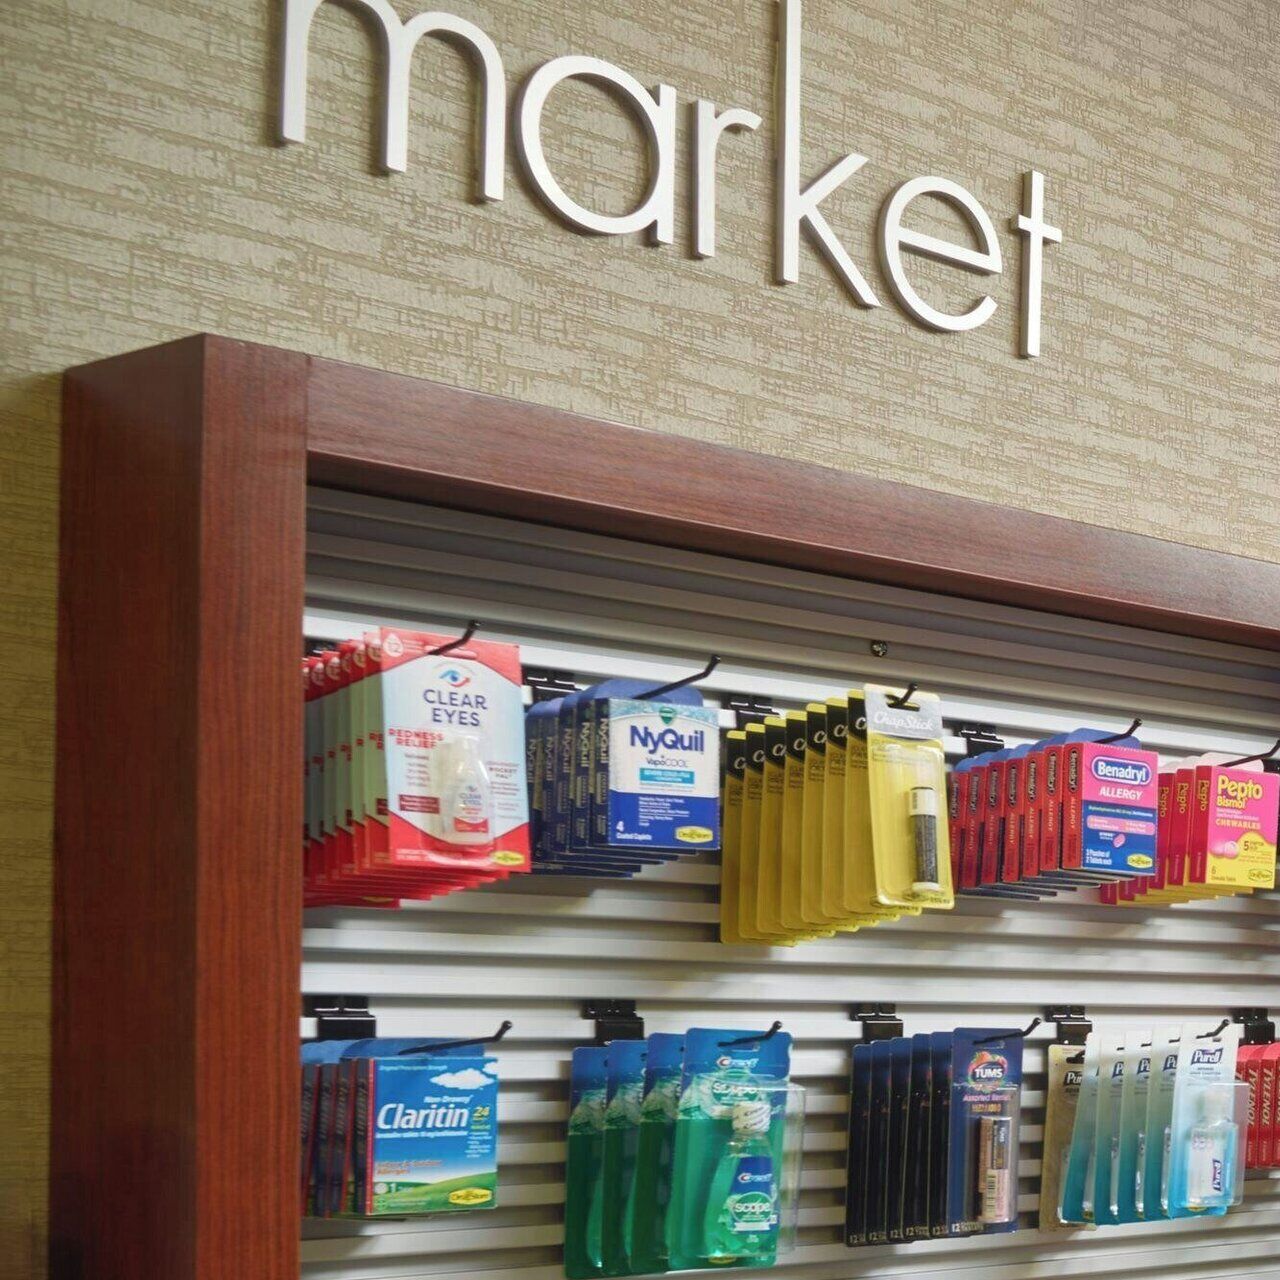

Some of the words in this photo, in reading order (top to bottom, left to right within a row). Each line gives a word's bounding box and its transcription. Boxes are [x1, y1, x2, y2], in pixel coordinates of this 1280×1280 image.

[280, 0, 1063, 358] market
[423, 688, 488, 711] CLEAR
[432, 707, 481, 727] EYES
[874, 710, 934, 732] ChapStick
[388, 728, 444, 741] REDNESS
[395, 738, 438, 749] RELIEF
[629, 725, 705, 754] NyQuil
[1097, 761, 1148, 785] Benadryl
[1099, 786, 1144, 801] ALLERGY
[1177, 781, 1189, 815] Pepto
[1198, 778, 1210, 812] Pepto
[1217, 774, 1264, 801] Pepto
[1158, 785, 1170, 818] Pepto
[1216, 796, 1247, 809] Bismol
[615, 820, 625, 832] 4
[1243, 840, 1249, 851] 5
[1192, 1049, 1223, 1066] Purell
[974, 1067, 1004, 1079] TUMS
[1262, 1067, 1272, 1128] TYLENOL
[377, 1102, 469, 1129] Claritin
[1213, 1160, 1222, 1190] Purell
[951, 1222, 960, 1233] 12
